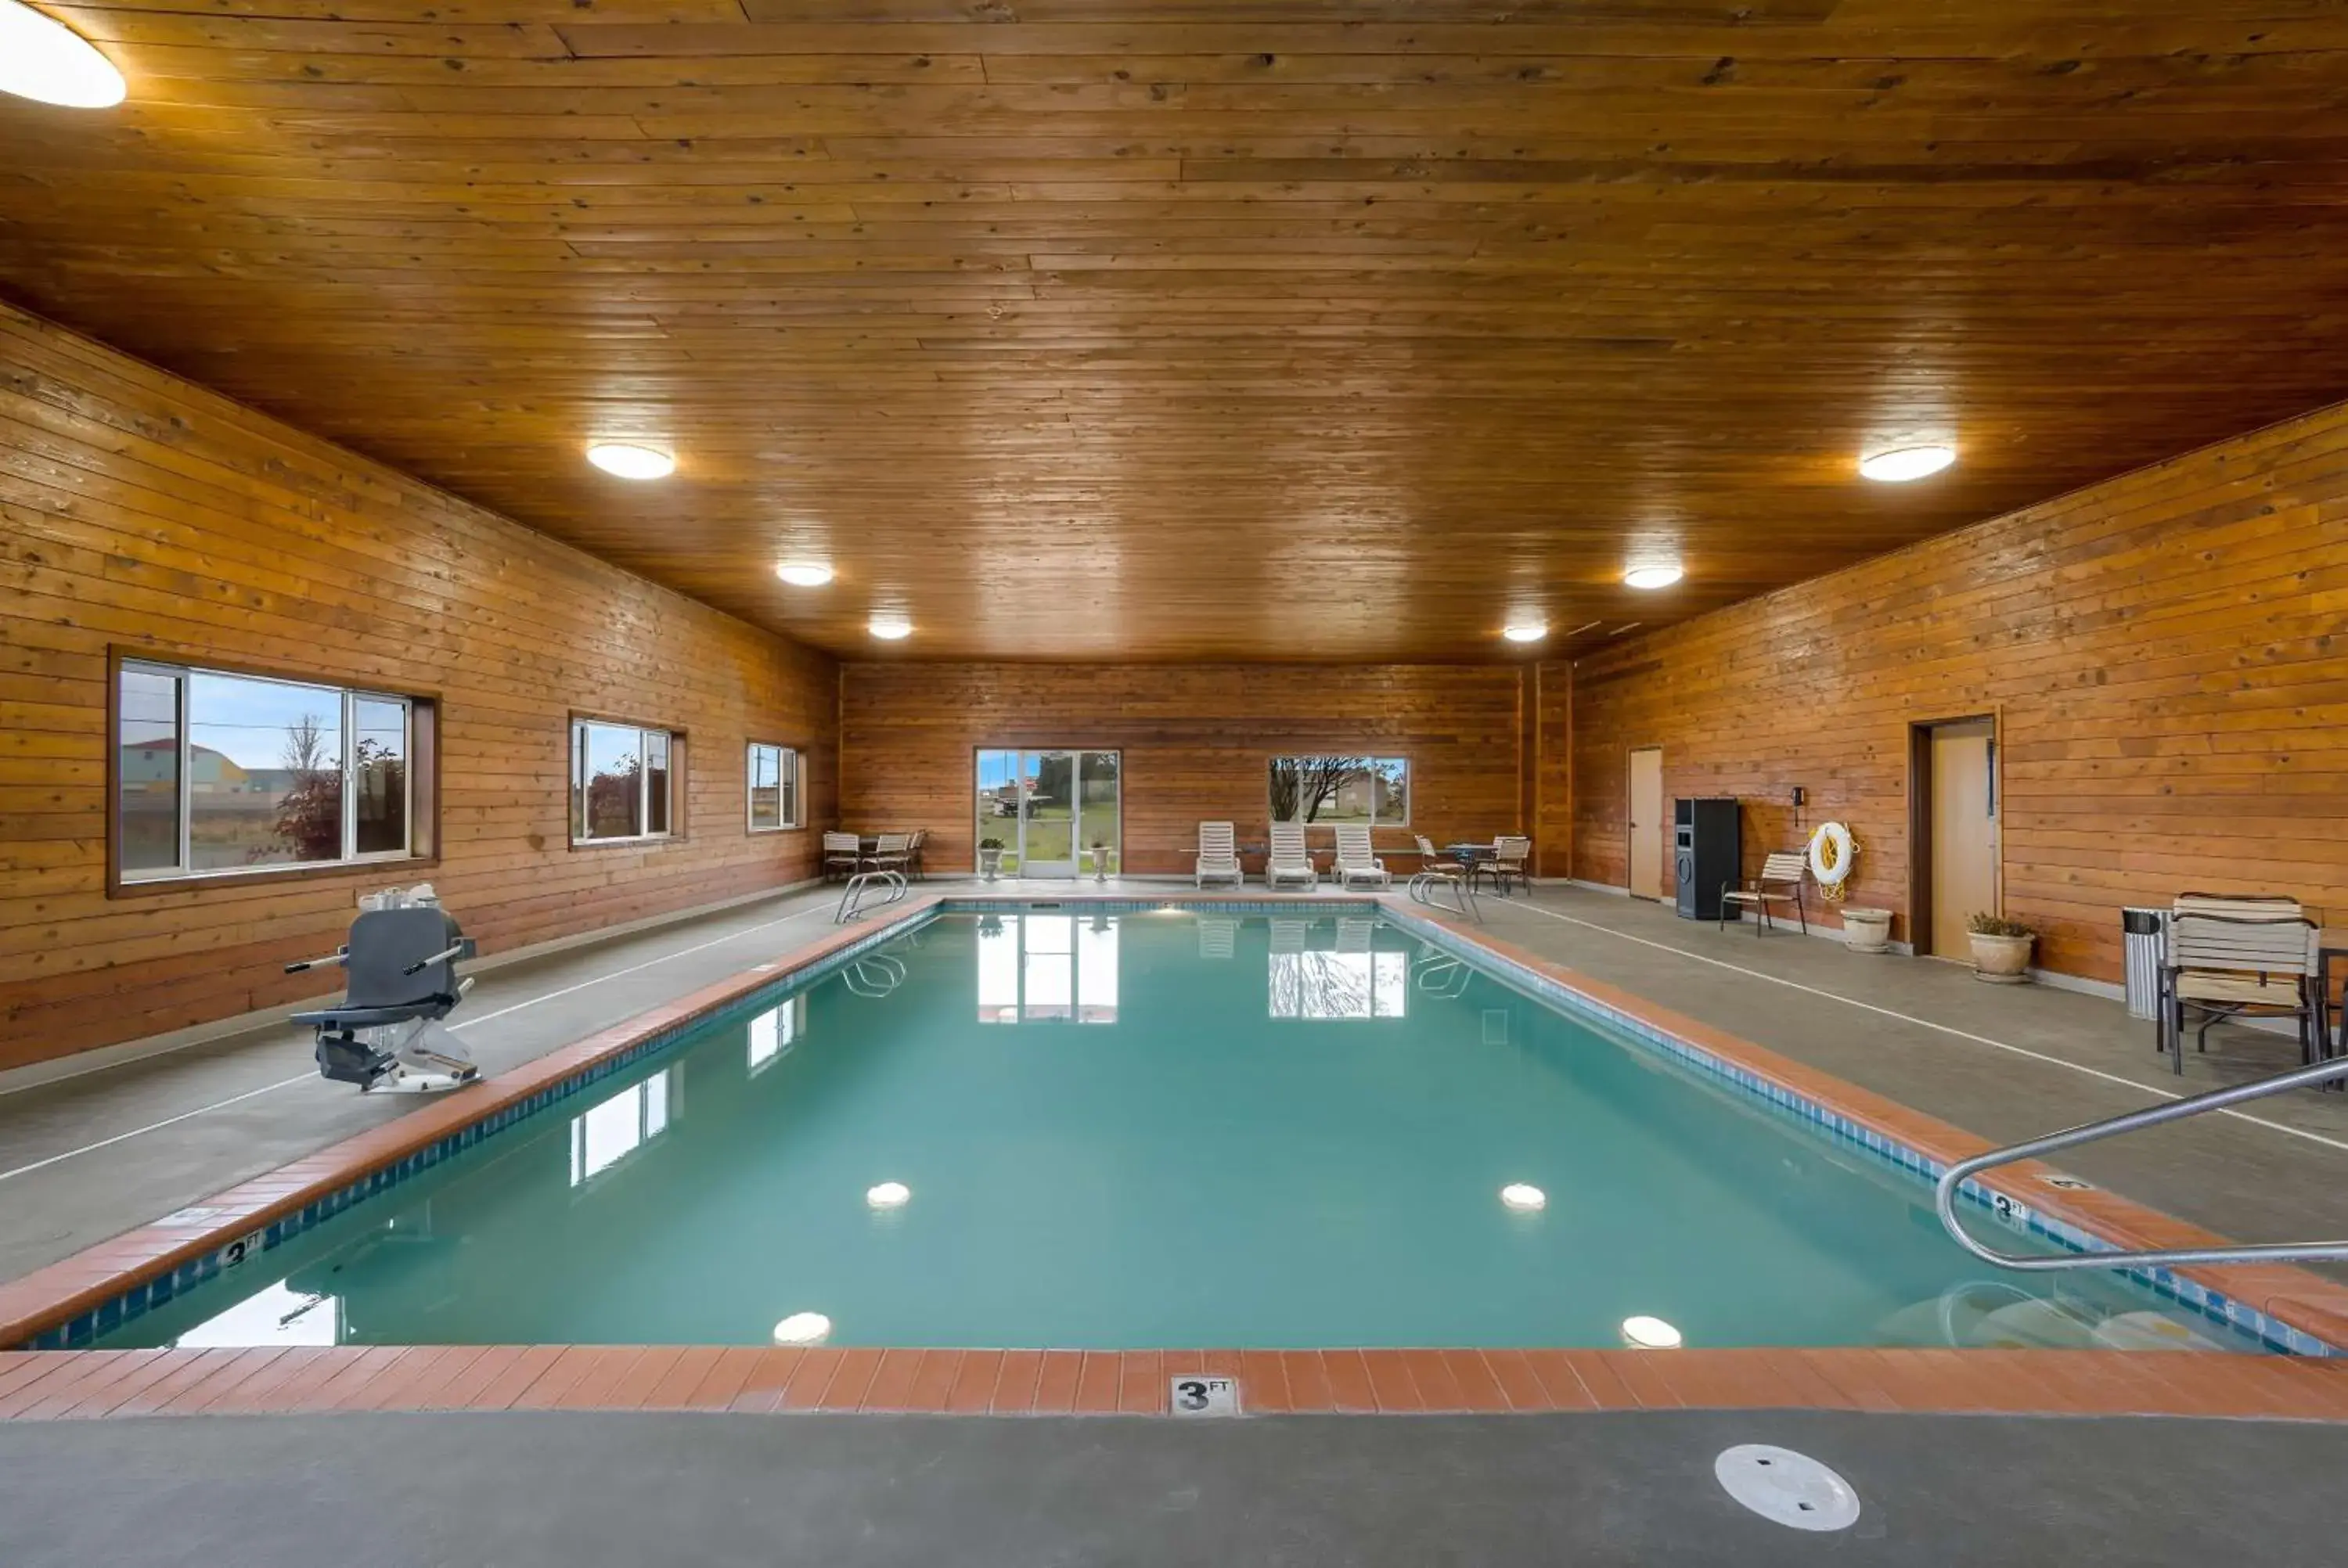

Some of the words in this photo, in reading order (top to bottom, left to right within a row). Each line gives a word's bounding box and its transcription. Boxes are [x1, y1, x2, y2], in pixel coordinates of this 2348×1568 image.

[247, 1232, 261, 1249] FT
[1178, 1381, 1209, 1411] 3
[1209, 1381, 1230, 1391] FT
